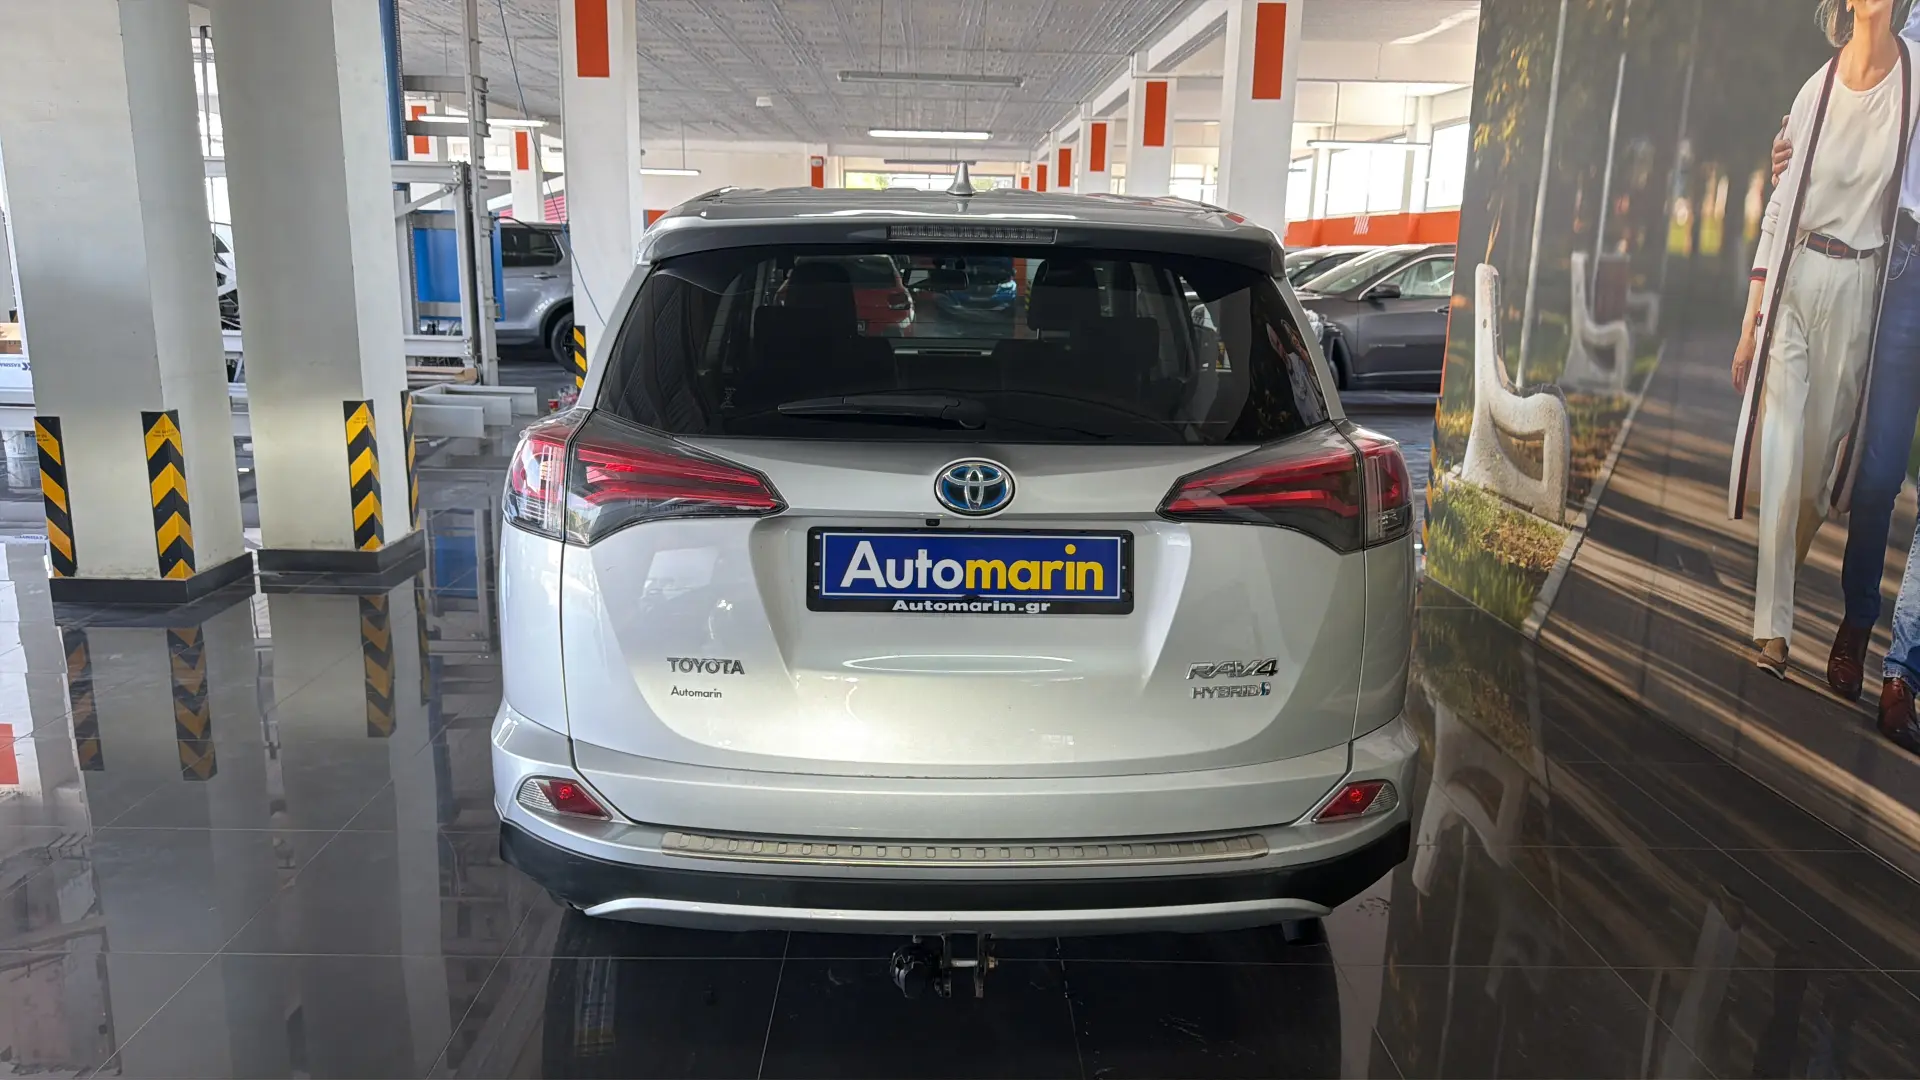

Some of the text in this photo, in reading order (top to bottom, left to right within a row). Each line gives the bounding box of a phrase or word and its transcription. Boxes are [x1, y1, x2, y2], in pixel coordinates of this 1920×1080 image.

[840, 540, 1104, 591] Automarin
[892, 600, 1051, 613] Automarin.gr
[666, 657, 745, 675] TOYOTA
[1185, 657, 1279, 681] RAV4
[670, 685, 723, 698] Automarin
[1191, 684, 1258, 699] HYBRID
